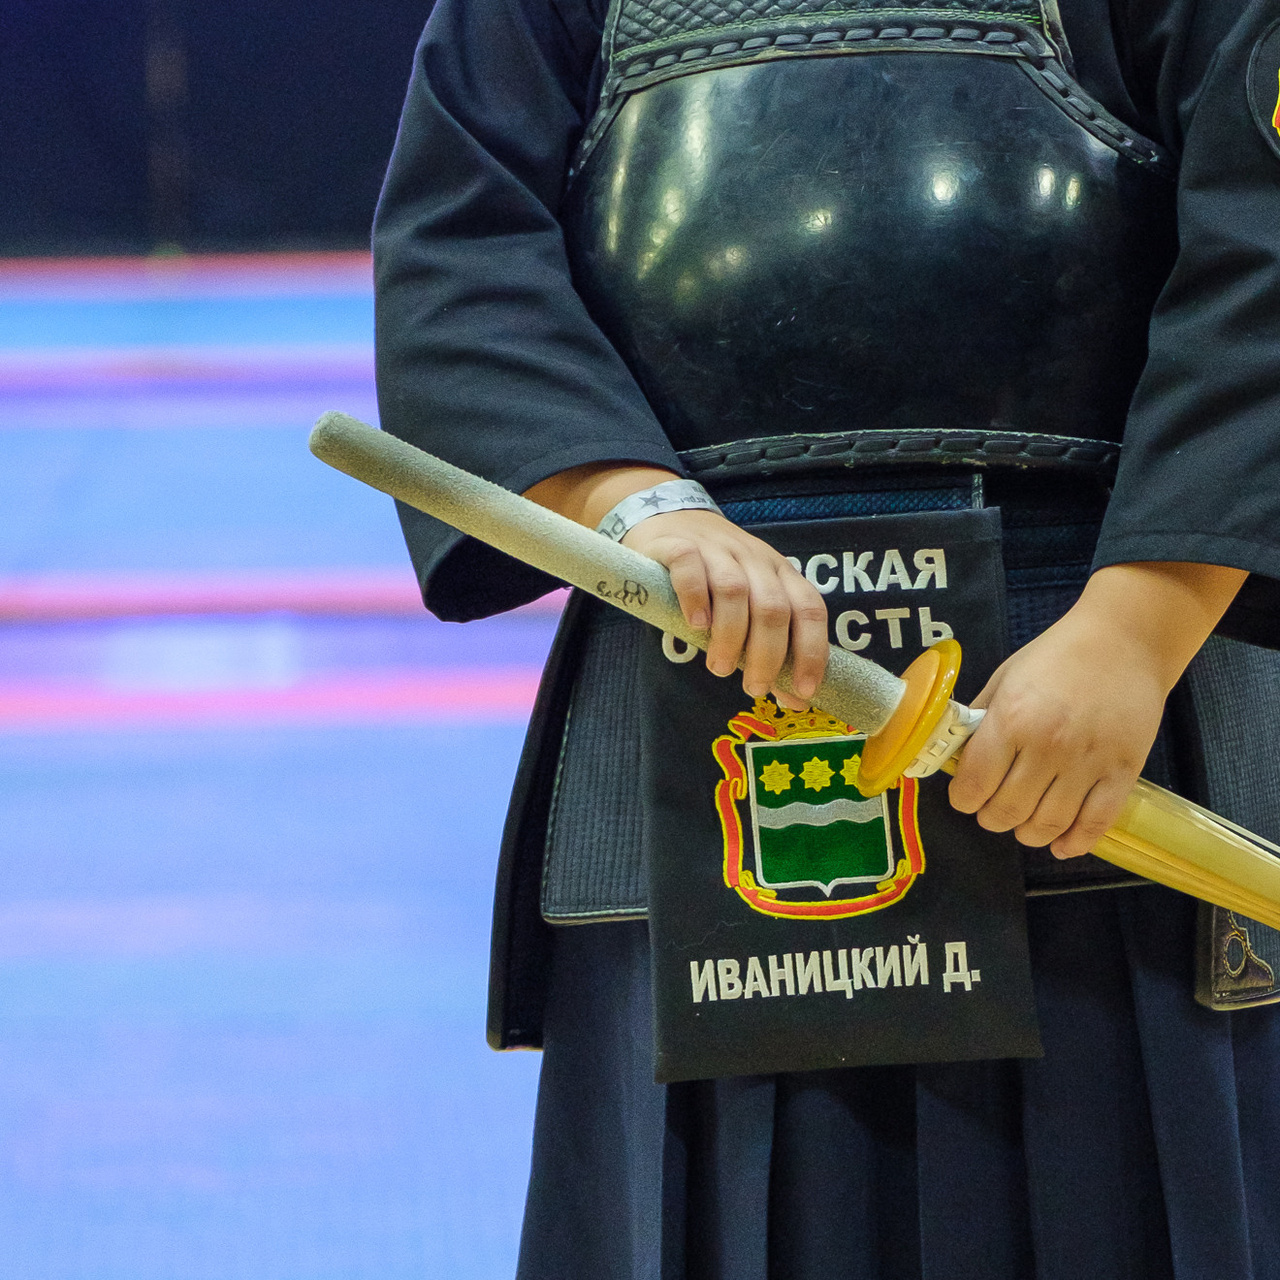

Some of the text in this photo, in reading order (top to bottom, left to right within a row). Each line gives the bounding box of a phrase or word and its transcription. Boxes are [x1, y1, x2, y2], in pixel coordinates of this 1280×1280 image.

[786, 548, 948, 595] СКАЯ
[661, 606, 954, 664] ОСТЬ
[689, 933, 981, 1004] ИВАНИЦКИЙ Д.
